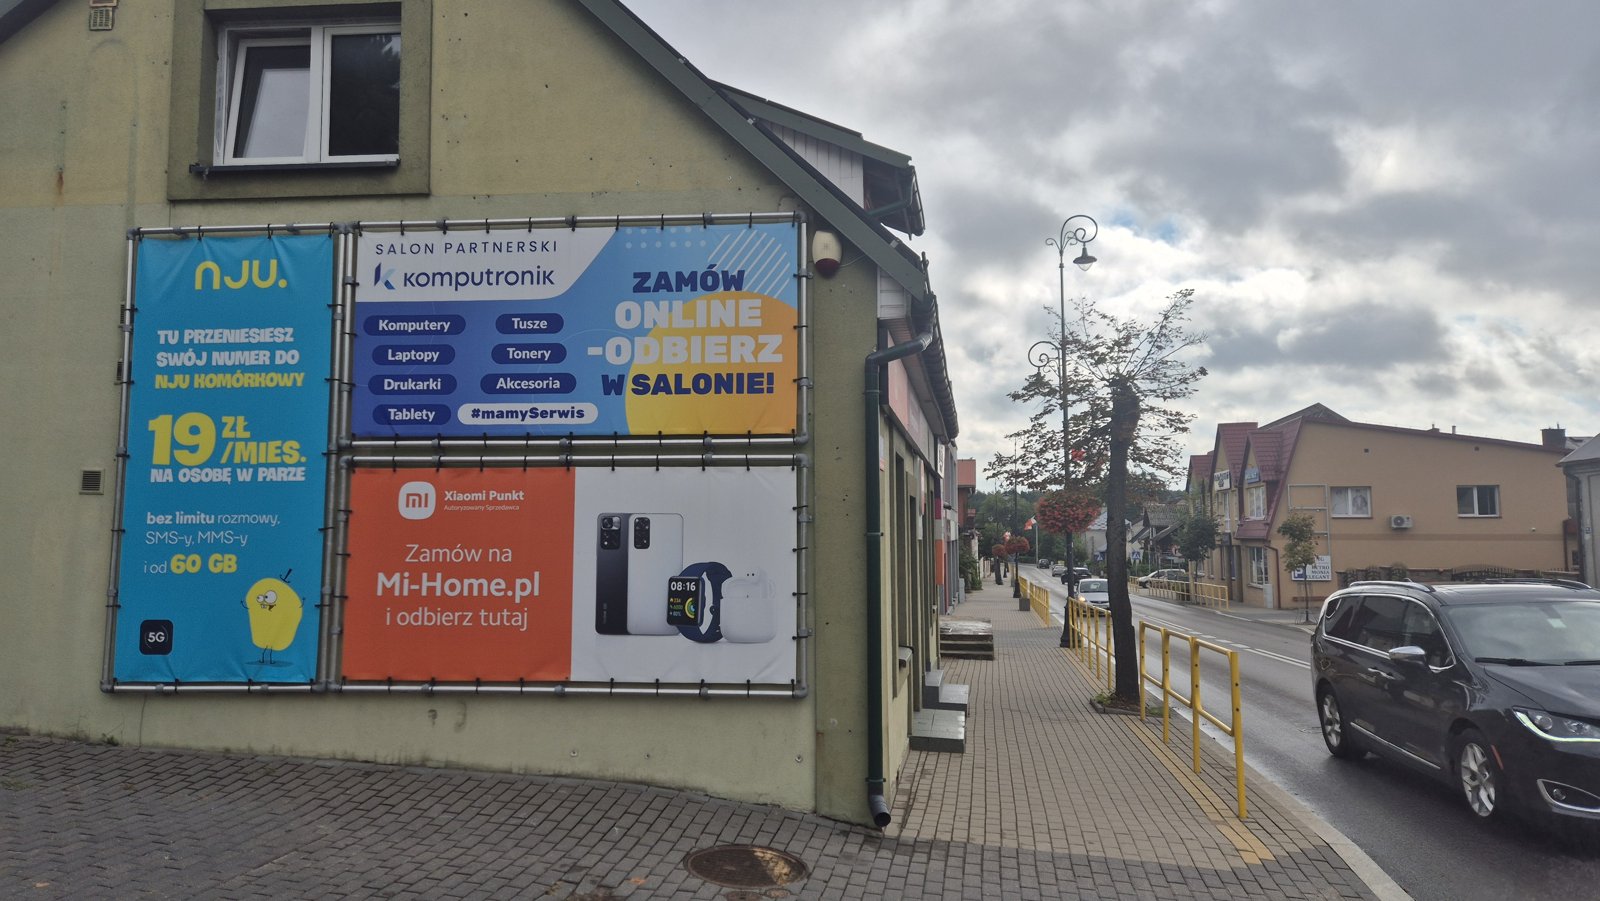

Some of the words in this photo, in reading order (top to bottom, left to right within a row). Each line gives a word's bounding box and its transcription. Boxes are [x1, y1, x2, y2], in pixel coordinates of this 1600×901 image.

[376, 243, 434, 255] SALON
[444, 240, 558, 255] PARTNERSKI
[403, 265, 555, 291] komputronik
[632, 263, 745, 293] ZAMÓW
[615, 298, 762, 329] ONLINE
[378, 318, 451, 333] Komputery
[511, 317, 548, 330] Tusze
[157, 330, 179, 345] TU
[183, 327, 294, 344] PRZENIESIESZ
[156, 348, 207, 367] SWÓJ
[211, 350, 270, 366] NUMER
[275, 350, 300, 365] DO
[387, 348, 440, 362] Laptopy
[506, 347, 551, 361] Tonery
[587, 334, 783, 365] -ODBIERZ
[155, 373, 190, 389] NJU
[194, 370, 305, 389] KOMÓRKOWY
[383, 378, 442, 391] Drukarki
[496, 377, 561, 389] Akcesoria
[601, 374, 625, 396] W
[631, 372, 775, 396] SALONIE!
[388, 407, 436, 422] Tablety
[470, 406, 585, 422] #mamySerwis
[221, 415, 251, 439] ZŁ
[148, 412, 216, 466] 19
[220, 440, 307, 465] /MIES.
[150, 468, 174, 483] NA
[178, 467, 232, 485] OSOBĘ
[236, 468, 253, 482] W
[257, 466, 306, 482] PARZE
[444, 490, 486, 501] Xiaomi
[489, 490, 525, 501] Punkt
[444, 504, 485, 512] Autoryzowany
[485, 504, 520, 512] Sprzedawca
[146, 512, 173, 525] bez
[175, 511, 215, 525] limitu
[217, 513, 280, 527] rozmowy,
[145, 531, 195, 547] SMS-y,
[197, 530, 248, 547] MMS-y
[404, 543, 482, 563] Zamów
[488, 547, 513, 563] na
[143, 560, 148, 574] i
[150, 560, 168, 574] od
[170, 553, 202, 575] 60
[208, 553, 238, 574] GB
[376, 571, 540, 604] Mi-Home.pl
[670, 581, 696, 592] 08:16
[386, 607, 391, 626] i
[396, 606, 473, 626] odbierz
[479, 607, 528, 632] tutaj
[147, 631, 166, 643] 5G
